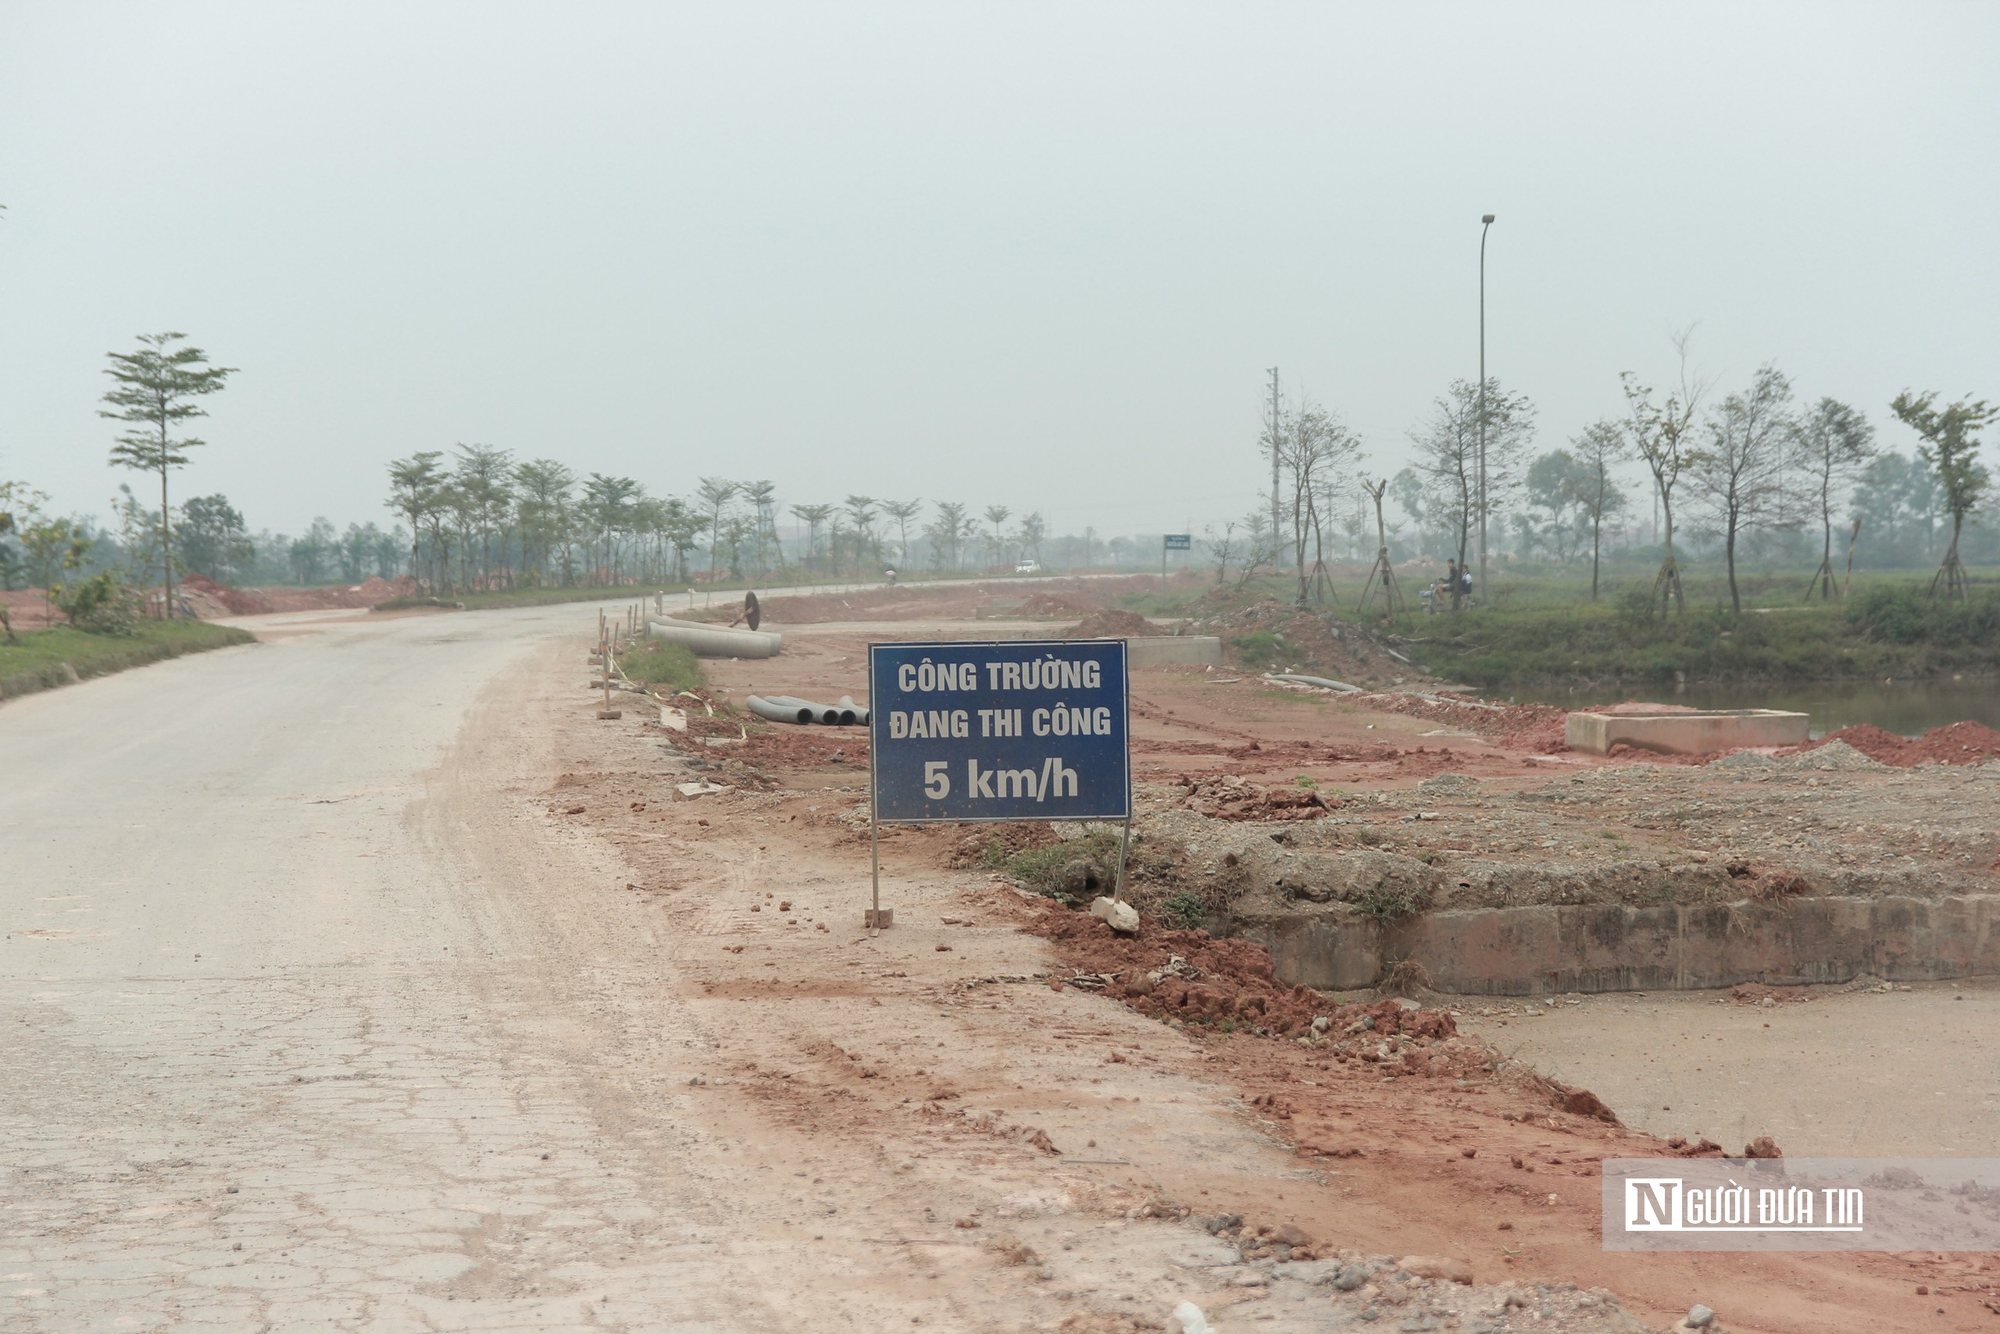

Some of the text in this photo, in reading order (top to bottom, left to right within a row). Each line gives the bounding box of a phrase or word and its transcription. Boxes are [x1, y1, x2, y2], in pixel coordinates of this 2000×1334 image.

[898, 653, 1101, 692] CÔNG TRƯỜNG
[889, 701, 1111, 739] ĐANG THI CÔNG
[924, 757, 1078, 802] 5 km/h
